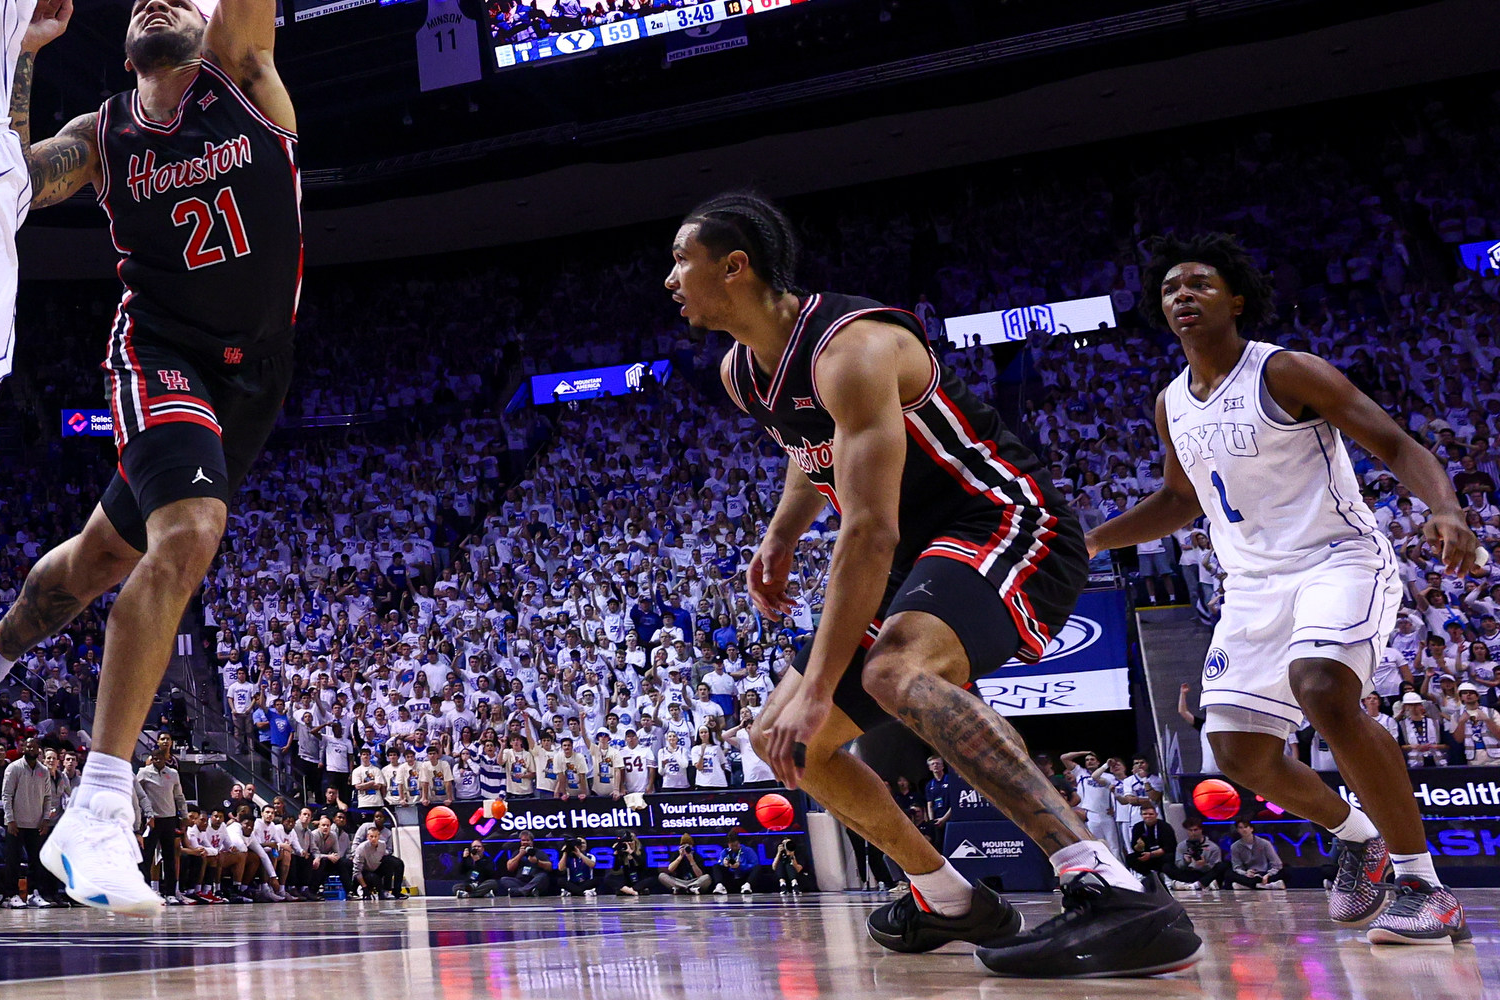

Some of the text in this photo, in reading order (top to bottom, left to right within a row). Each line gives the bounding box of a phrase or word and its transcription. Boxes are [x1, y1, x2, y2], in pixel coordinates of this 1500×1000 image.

[297, 10, 321, 21] MEN'S
[426, 13, 463, 30] MINSON
[609, 23, 632, 41] 59
[677, 4, 715, 27] 3:49
[434, 28, 456, 52] 11
[695, 37, 746, 55] BASKETBALL
[127, 133, 251, 202] Houston
[170, 186, 251, 271] 21
[1174, 423, 1258, 473] BYU
[1211, 471, 1245, 523] 1
[623, 756, 644, 772] 54
[669, 763, 680, 772] 26
[660, 801, 748, 815] Your insurance
[501, 807, 641, 831] Select Health
[662, 815, 740, 828] assist leader.
